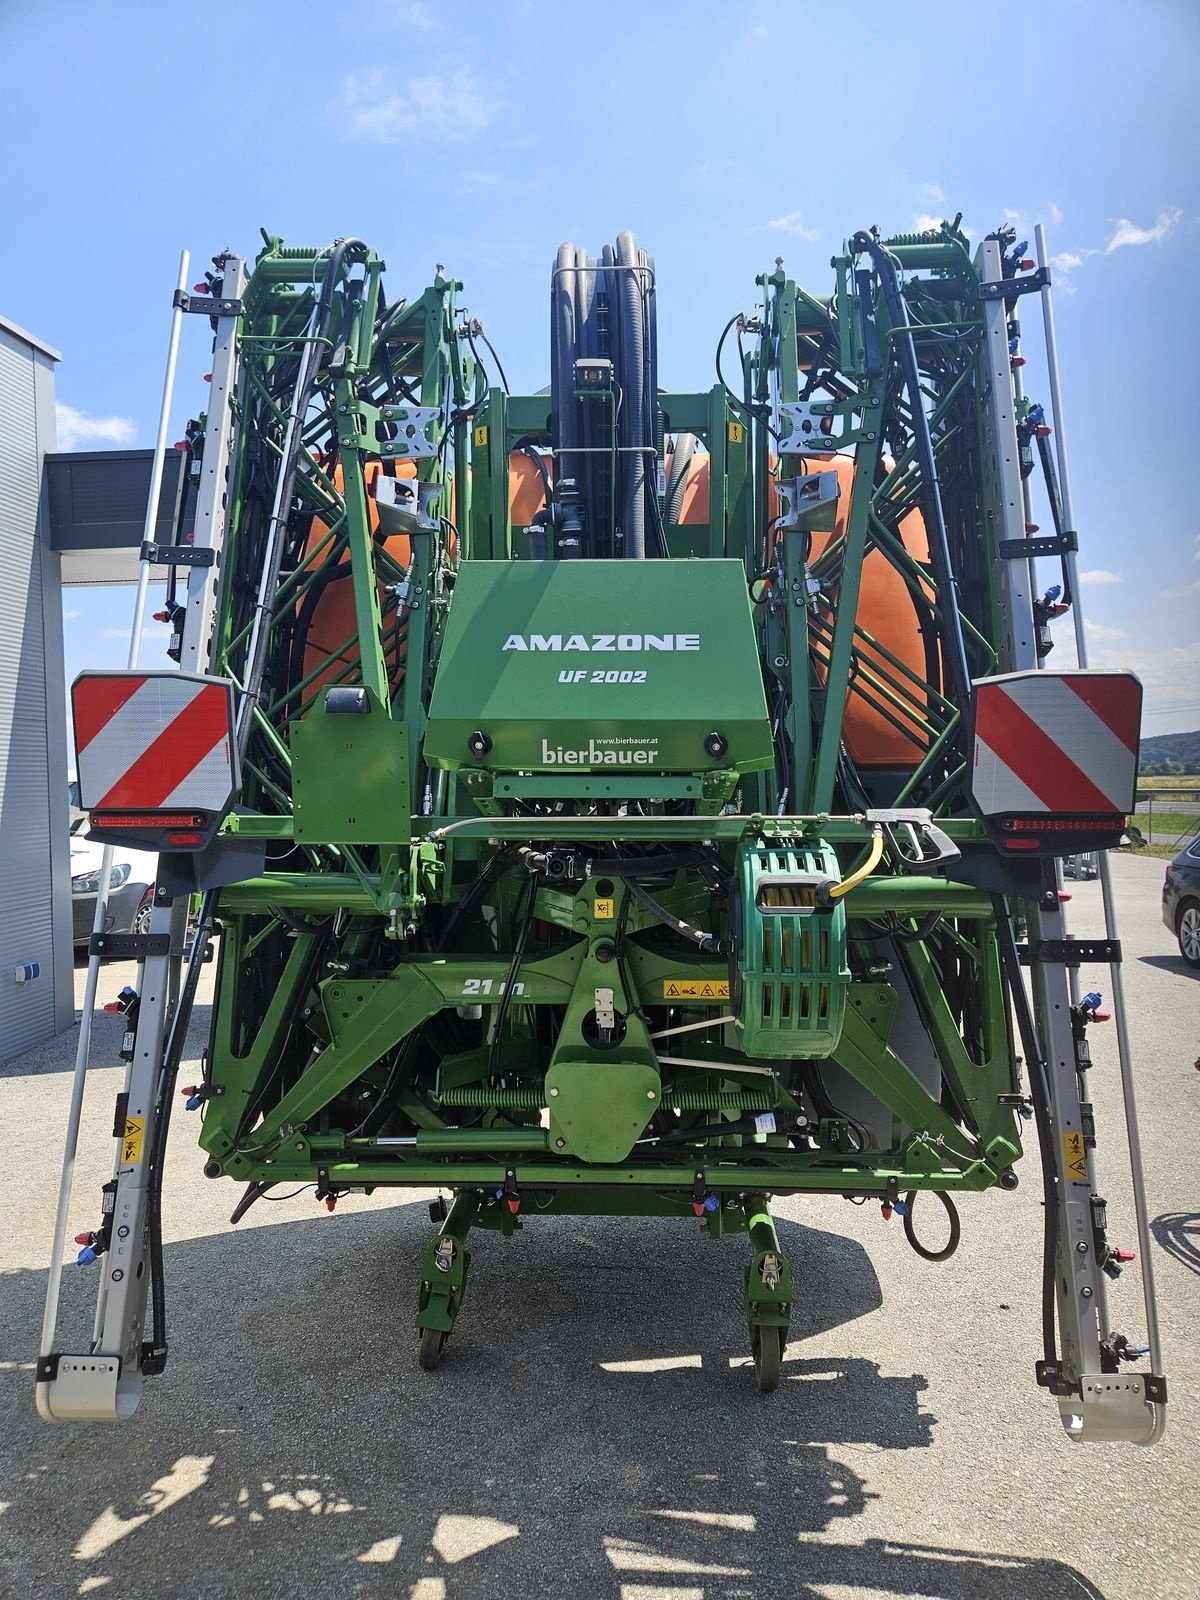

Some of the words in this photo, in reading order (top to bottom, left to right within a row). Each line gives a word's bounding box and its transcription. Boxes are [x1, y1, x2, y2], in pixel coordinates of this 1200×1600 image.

[501, 634, 700, 651] AMAZONE
[558, 670, 588, 683] UF
[590, 670, 648, 683] 2002
[596, 737, 659, 745] www.bierbauer.at
[542, 739, 659, 764] bierbauer
[461, 979, 493, 995] 21
